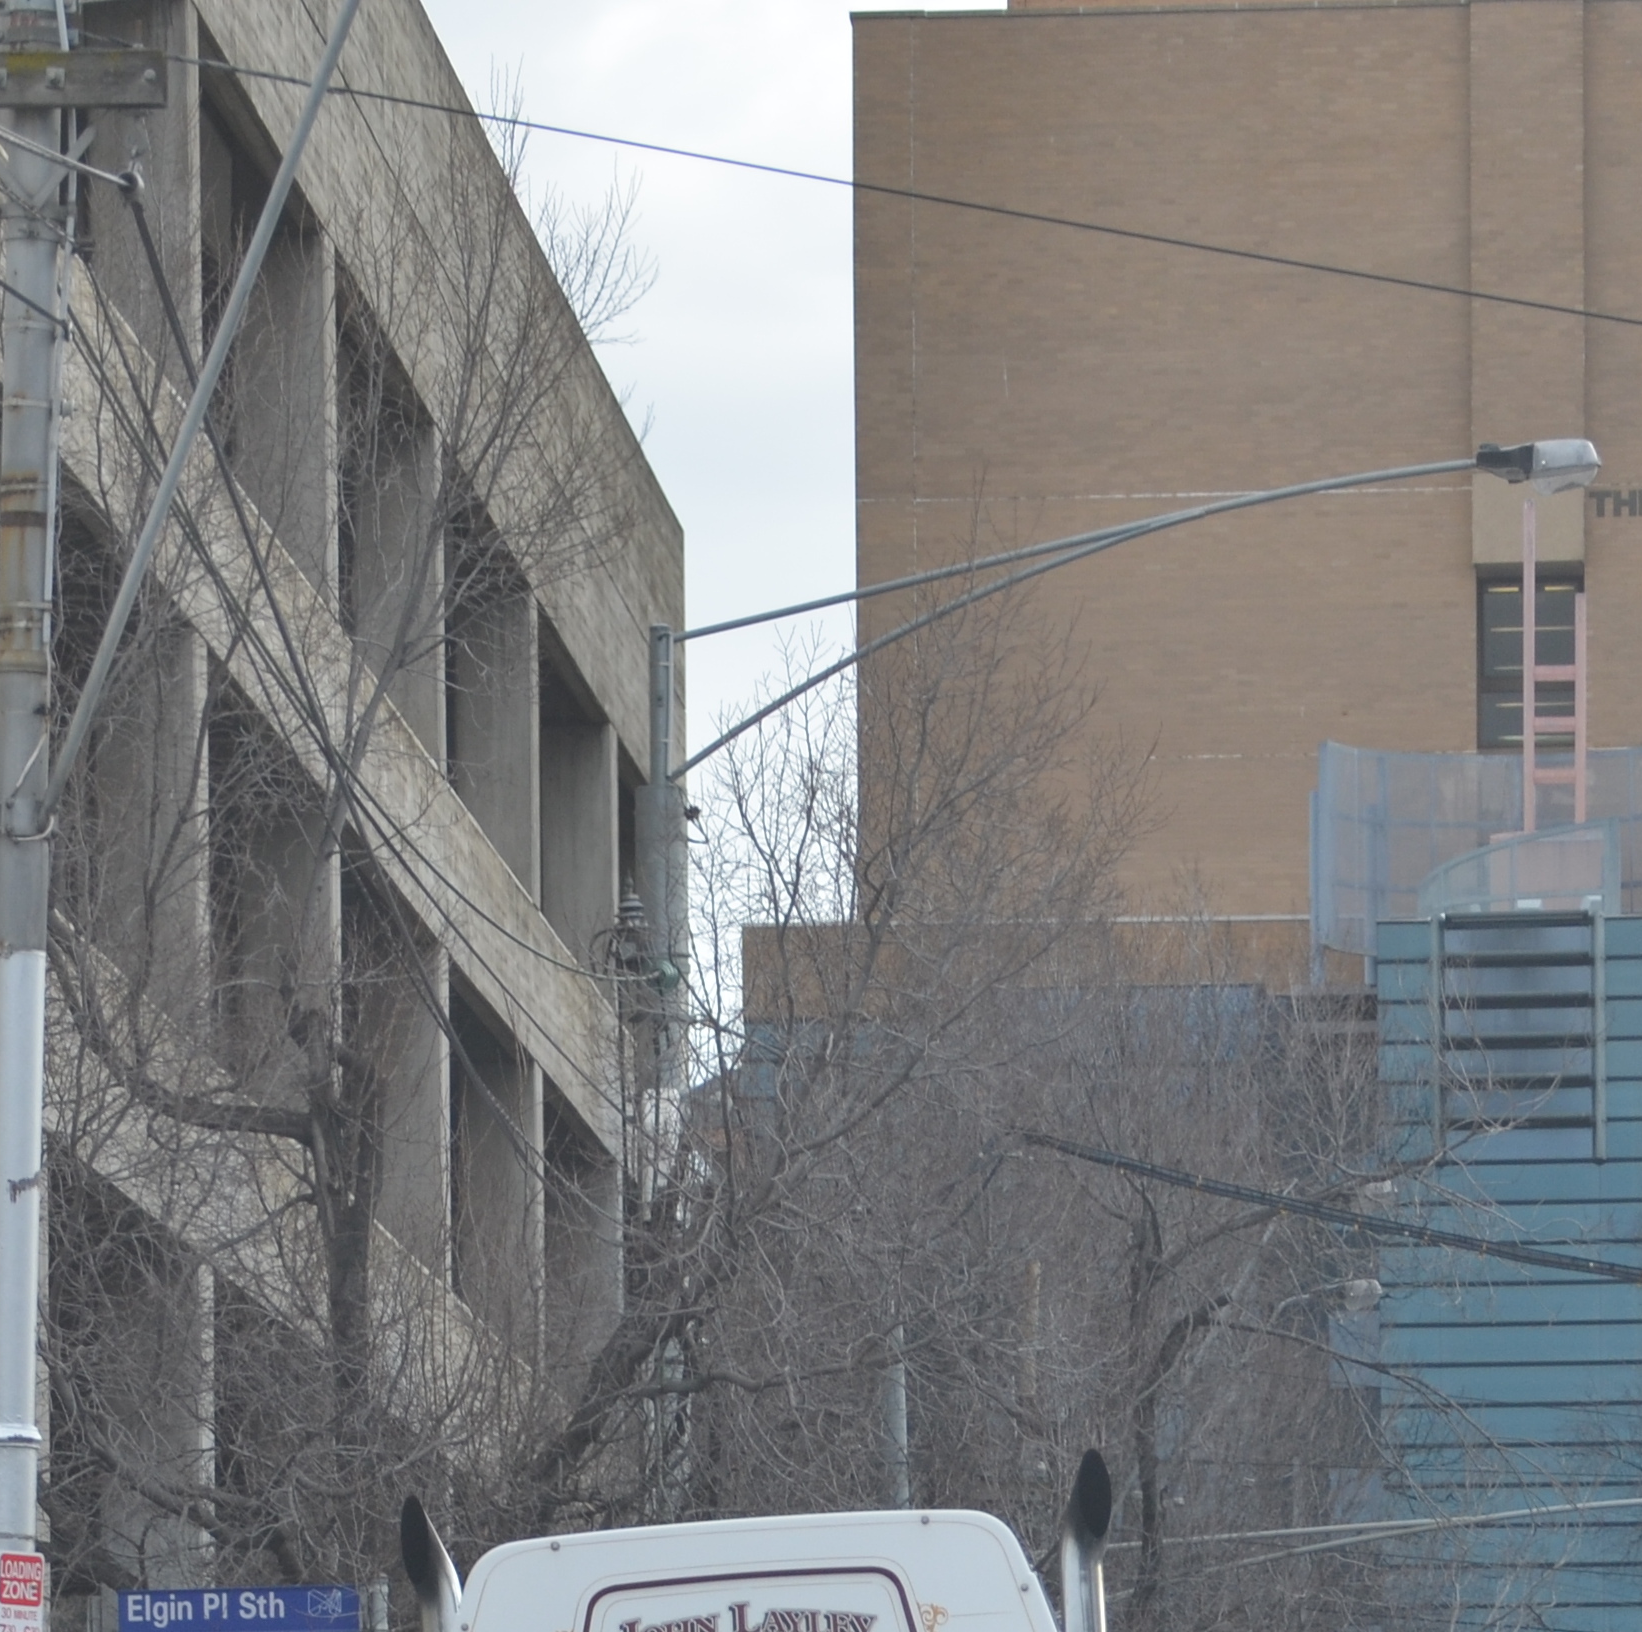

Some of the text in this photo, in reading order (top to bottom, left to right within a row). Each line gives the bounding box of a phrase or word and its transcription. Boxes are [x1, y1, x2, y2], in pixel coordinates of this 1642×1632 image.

[0, 1559, 42, 1581] LOADING
[2, 1580, 39, 1600] ZONE
[1, 1607, 12, 1619] 30
[127, 1591, 285, 1628] Elgin Pl Sth
